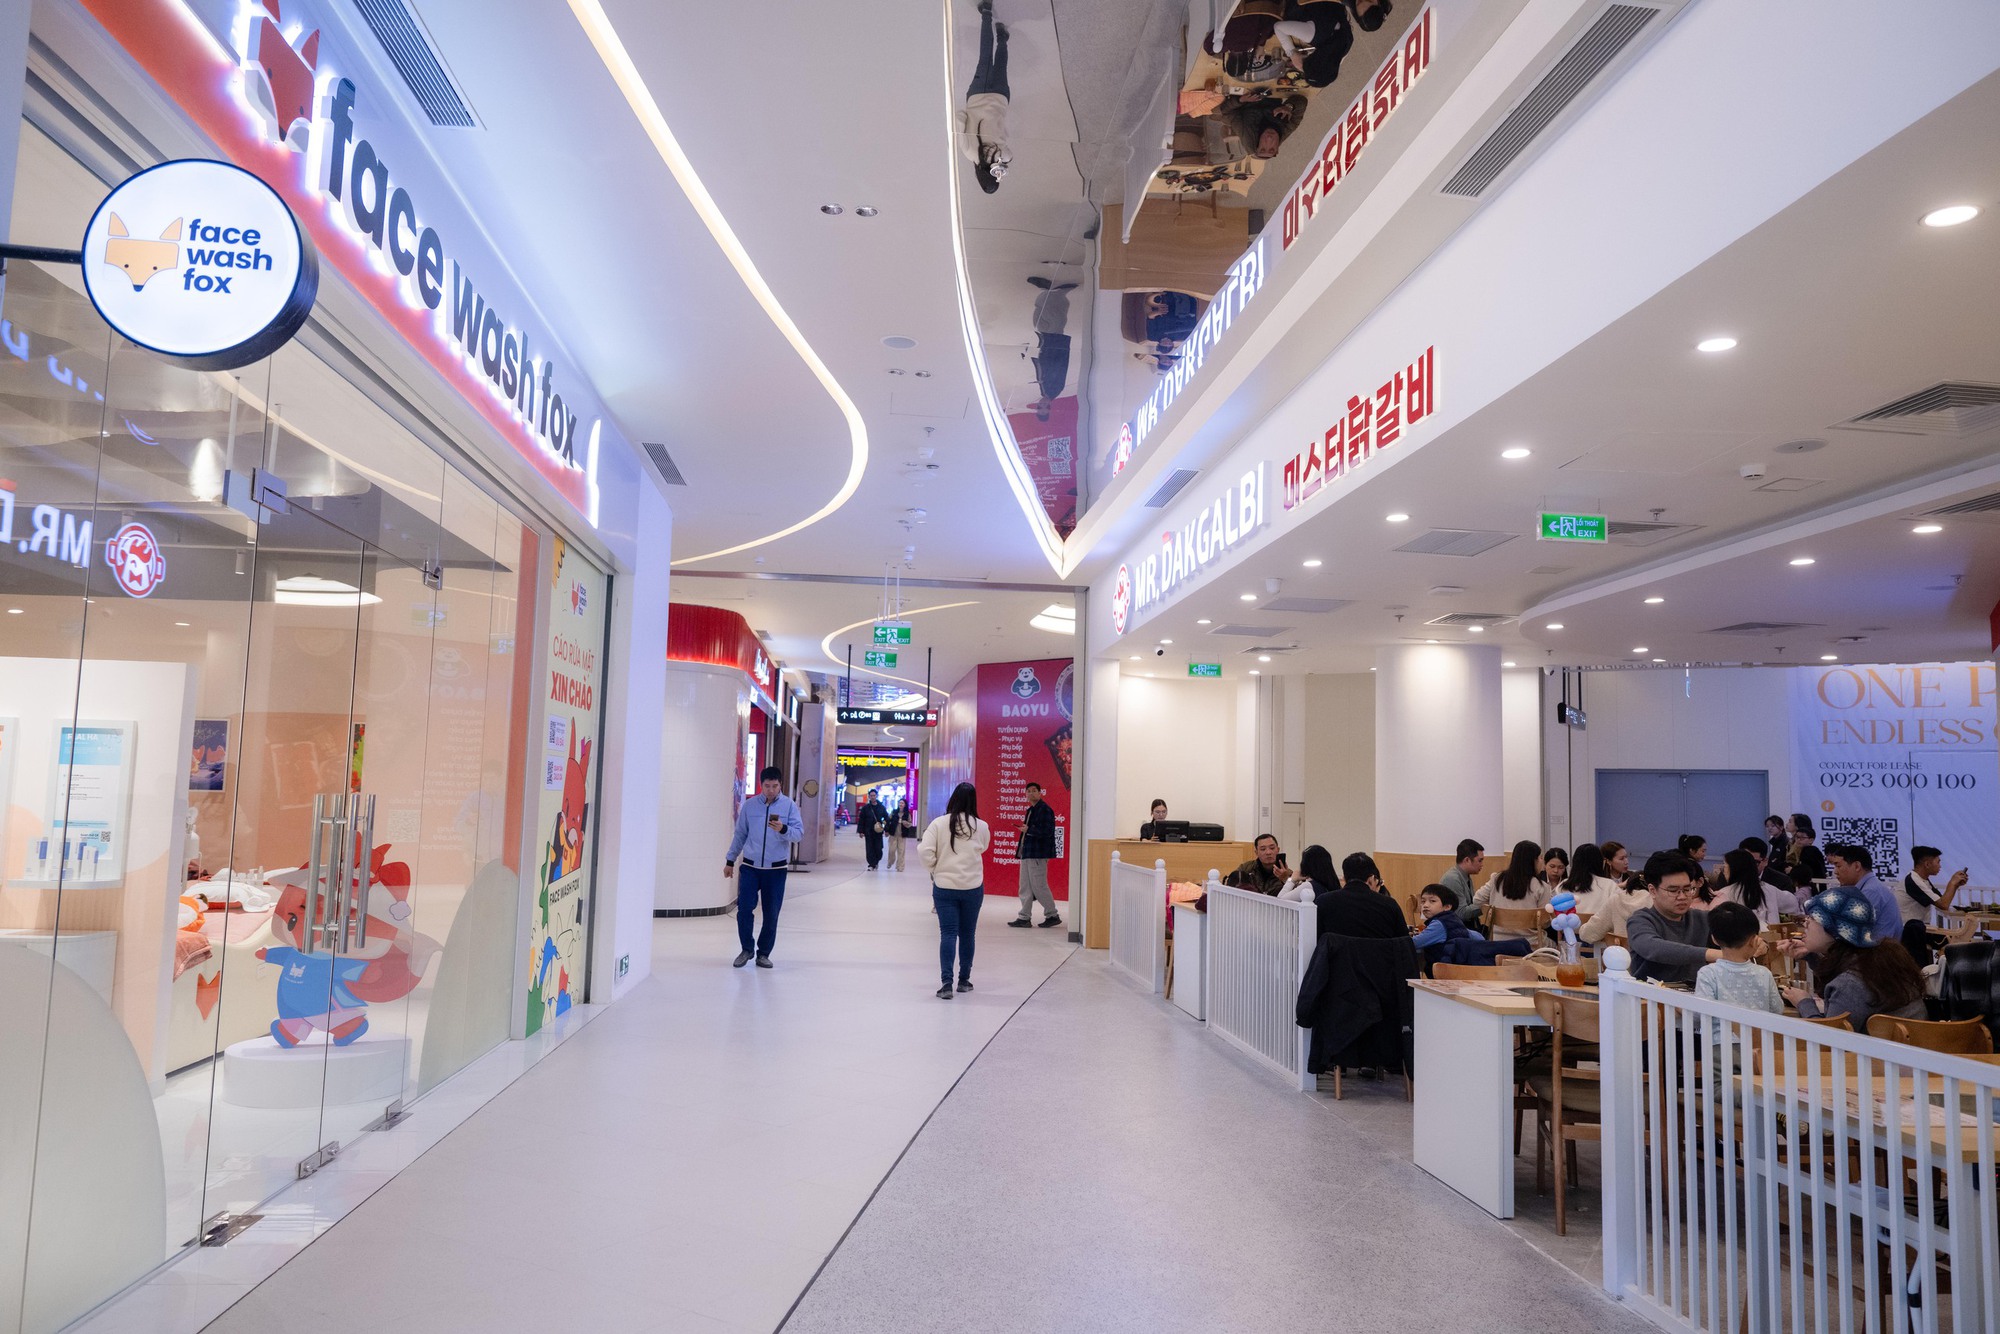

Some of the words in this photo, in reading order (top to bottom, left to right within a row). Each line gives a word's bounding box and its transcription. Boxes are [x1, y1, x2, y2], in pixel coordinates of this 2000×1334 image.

[189, 218, 261, 246] face
[187, 248, 273, 271] wash
[329, 77, 443, 310] face
[453, 259, 534, 424] wash
[541, 360, 577, 468] fox
[183, 268, 233, 294] fox
[1284, 344, 1434, 511] 미스터닭갈비
[1135, 554, 1159, 611] MR.
[1161, 460, 1265, 593] DAKGALBI
[1577, 530, 1598, 538] EXIT
[553, 632, 568, 661] CÁO
[550, 670, 568, 704] XIN
[569, 675, 593, 711] CHÀO
[1817, 666, 1947, 710] ONE
[1002, 703, 1049, 717] BAOYU
[1821, 718, 1985, 745] ENDLESS
[1819, 761, 1864, 770] CONTACT
[1867, 762, 1888, 770] FOR
[1890, 762, 1922, 770] LEASE
[1820, 772, 1874, 788] 0923
[1881, 772, 1928, 789] 000
[1937, 773, 1976, 789] 100
